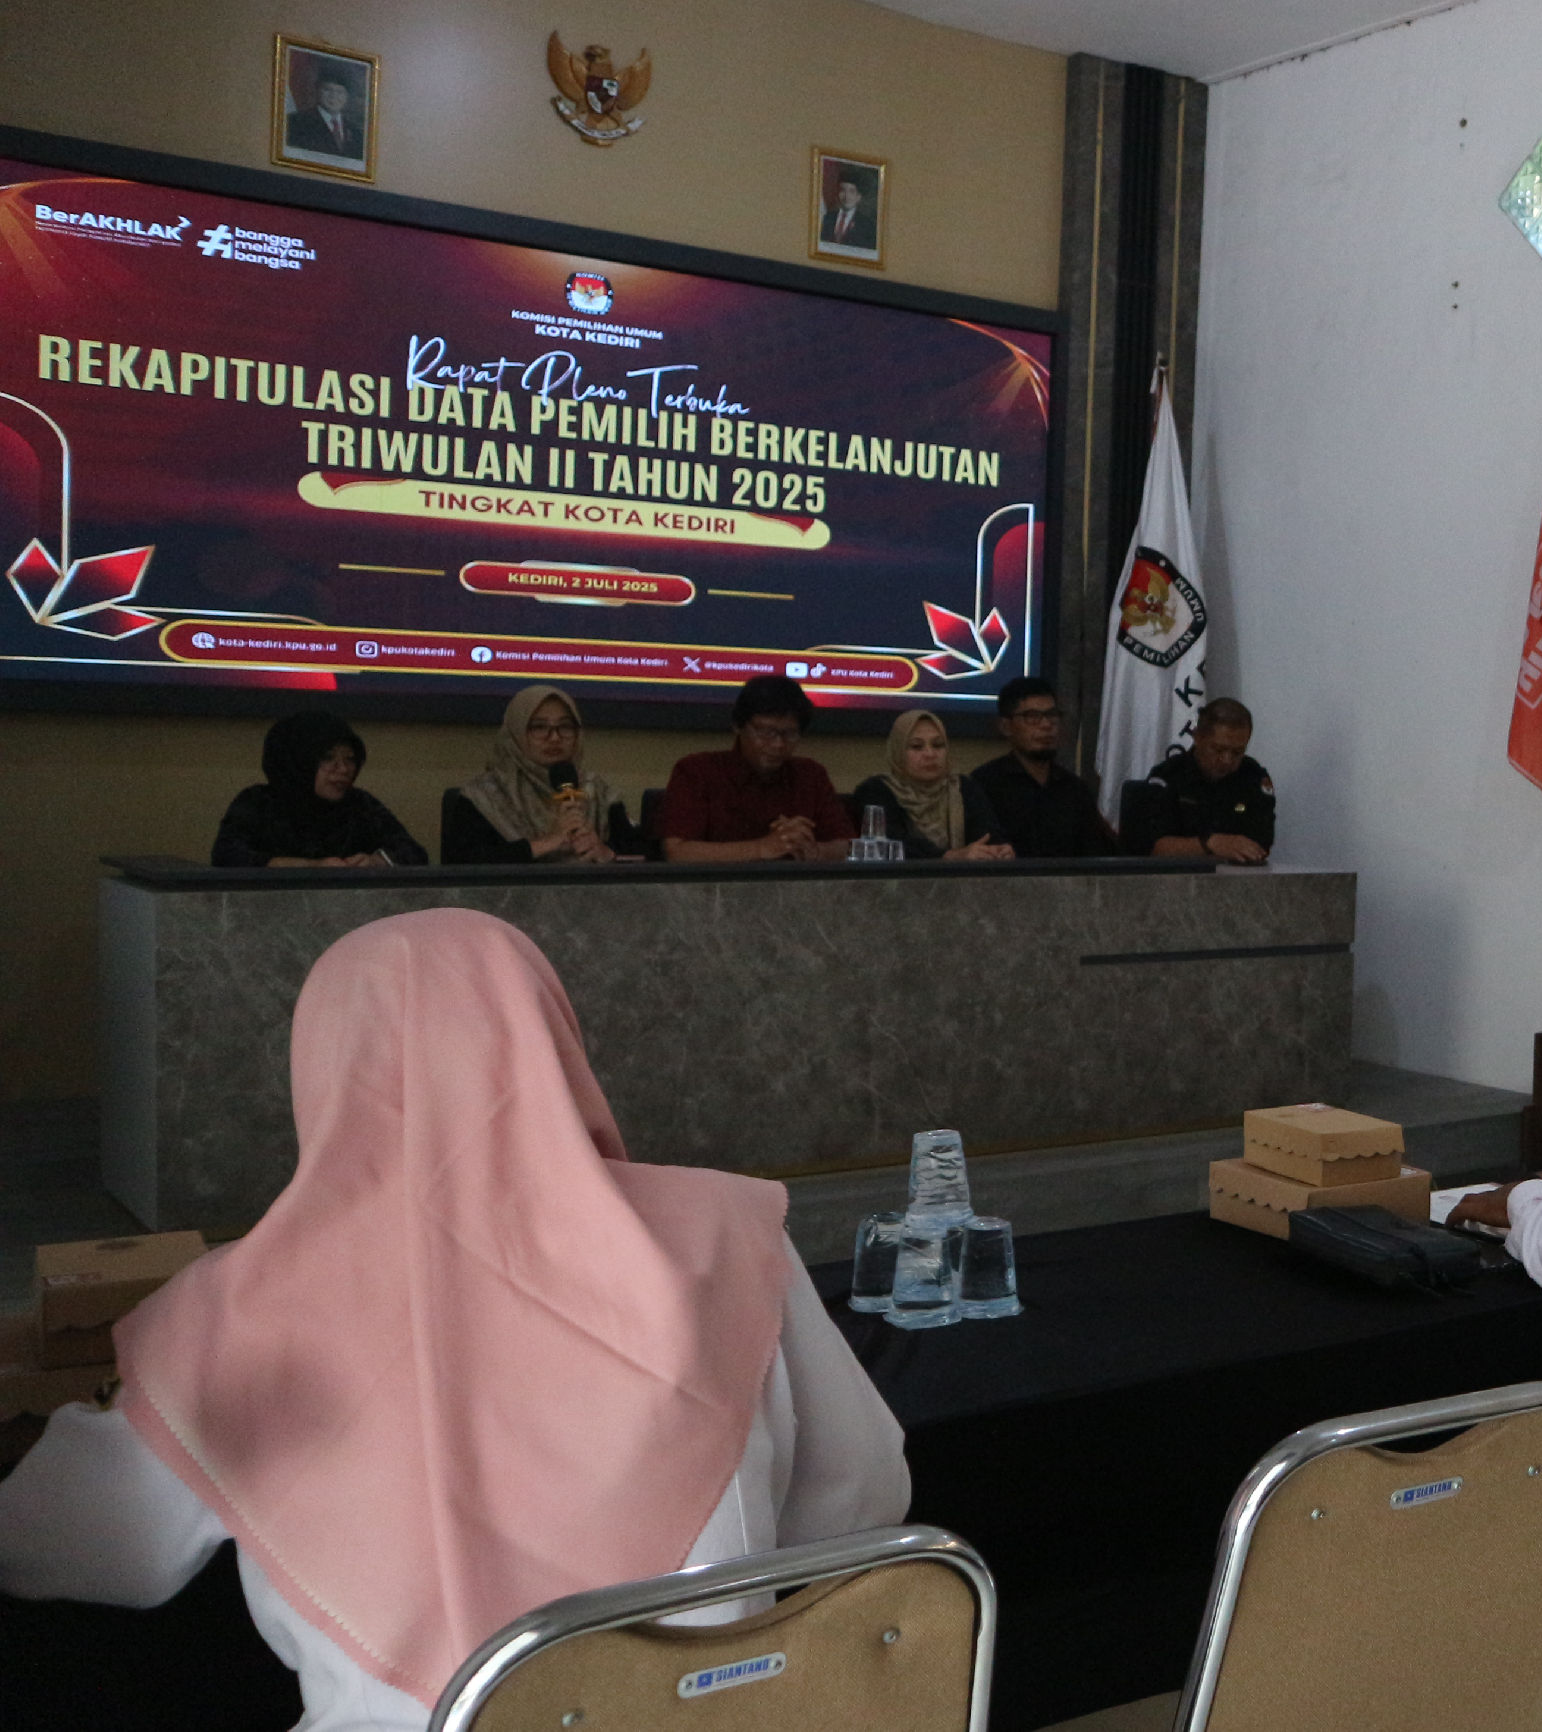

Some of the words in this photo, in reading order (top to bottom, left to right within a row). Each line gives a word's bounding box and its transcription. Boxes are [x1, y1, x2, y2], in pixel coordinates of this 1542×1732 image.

[35, 204, 183, 241] BerAKHLAK
[235, 226, 305, 248] bangga
[234, 250, 303, 271] bangsa
[235, 239, 317, 261] melayani
[511, 309, 555, 324] KOMISI
[557, 315, 624, 335] PEMILIHAN
[625, 325, 664, 341] UMUM
[534, 323, 583, 342] KOTA
[585, 331, 642, 350] KEDIRI
[406, 334, 526, 393] Rapat
[521, 350, 628, 407] Pleno
[626, 364, 750, 419] Terbuka
[37, 333, 391, 419] REKAPITULASI
[408, 382, 517, 433] DATA
[530, 395, 696, 454] PEMILIH
[711, 417, 1000, 488] BERKELANJUTAN
[301, 420, 533, 487] TRIWULAN
[549, 447, 576, 490] II
[588, 450, 719, 504] TAHUN
[731, 467, 827, 514] 2025
[418, 489, 555, 519] TINGKAT
[564, 503, 644, 527] KOTA
[653, 511, 736, 535] KEDIRI
[508, 571, 567, 588] KEDIRI,
[571, 577, 581, 588] 2
[584, 577, 618, 591] JULI
[622, 580, 659, 593] 2025
